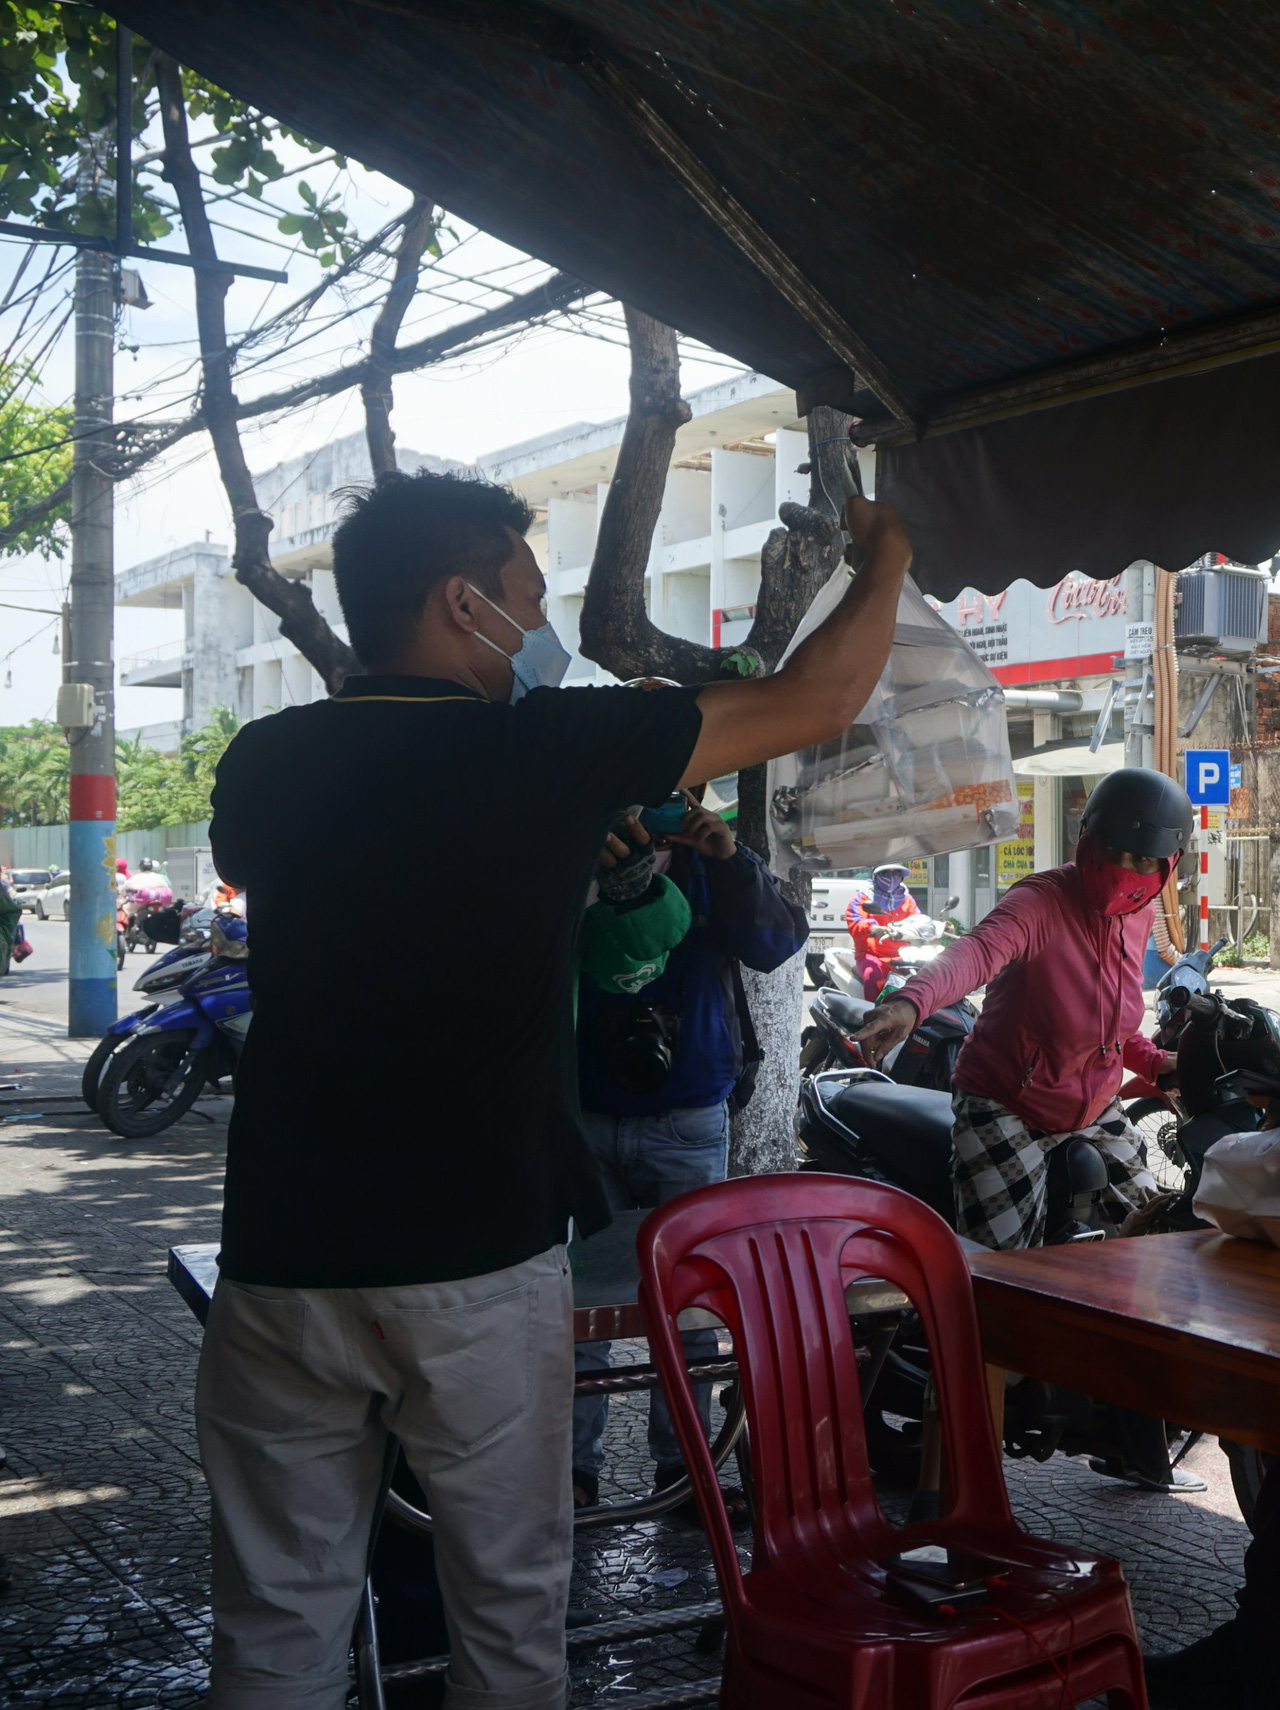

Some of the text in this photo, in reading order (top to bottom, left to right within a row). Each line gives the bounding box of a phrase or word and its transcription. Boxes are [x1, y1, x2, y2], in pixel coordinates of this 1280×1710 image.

[1199, 763, 1220, 793] P
[181, 957, 203, 968] YAMAHA
[912, 1032, 931, 1048] YAMAHA
